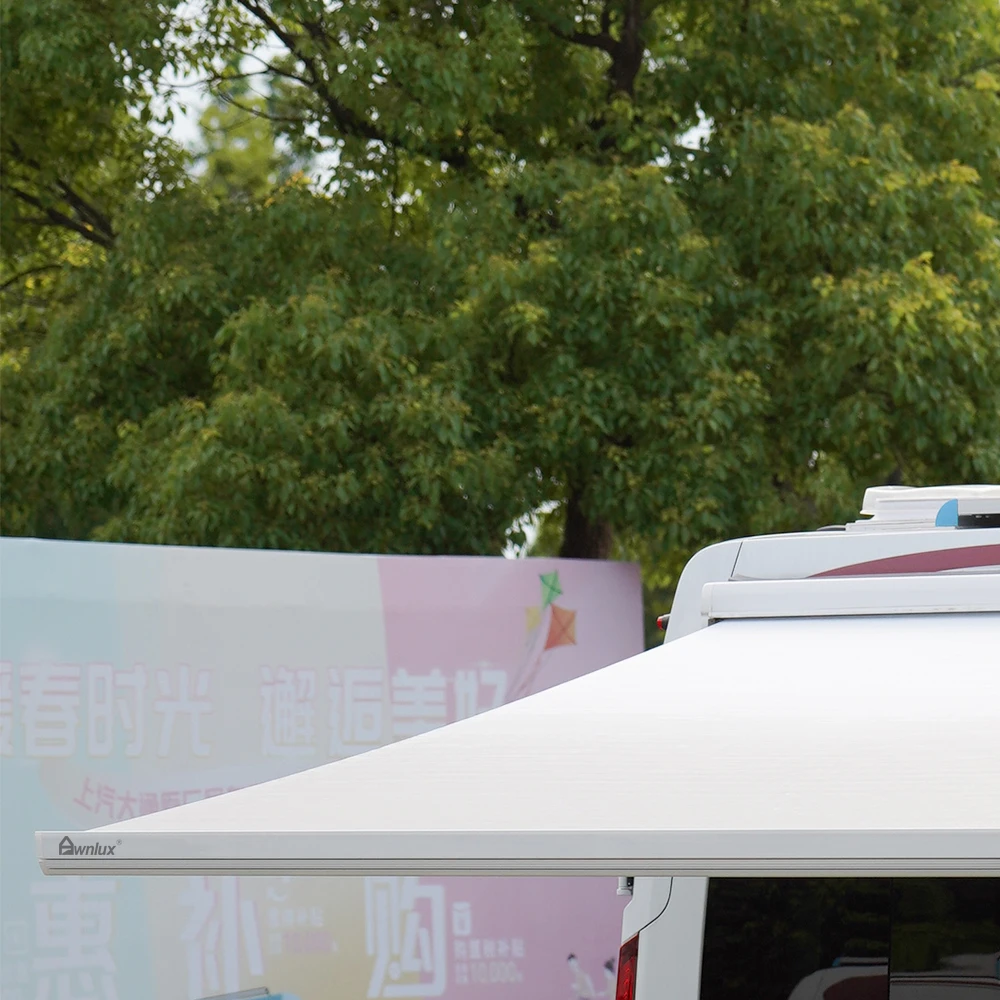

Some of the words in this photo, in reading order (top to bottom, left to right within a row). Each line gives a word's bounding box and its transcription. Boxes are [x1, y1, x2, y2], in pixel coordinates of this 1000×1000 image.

[0, 659, 212, 758] 春时光
[59, 835, 116, 856] Awnlux
